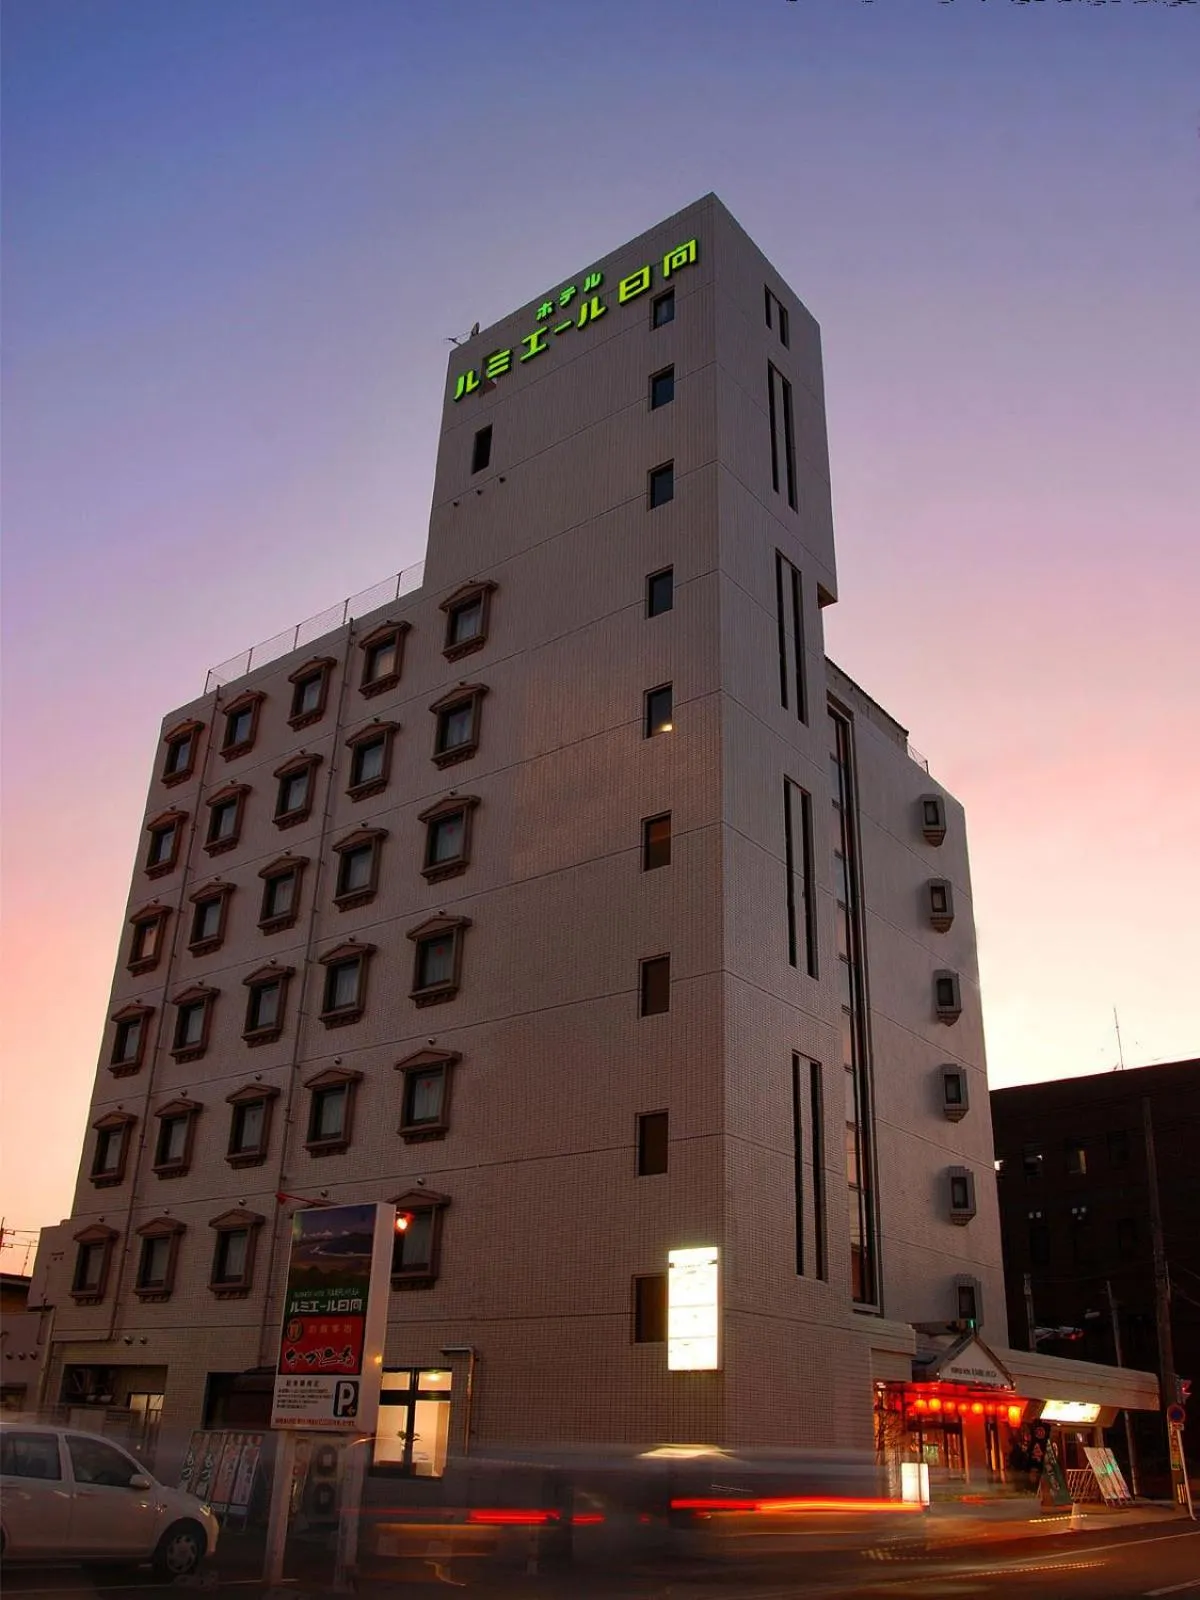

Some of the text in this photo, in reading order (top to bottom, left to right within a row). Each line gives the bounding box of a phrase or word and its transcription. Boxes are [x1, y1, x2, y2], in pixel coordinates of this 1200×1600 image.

[536, 272, 604, 321] ホテル
[454, 239, 697, 401] ルミエール日向
[290, 1299, 363, 1313] ルミエール日向
[336, 1382, 355, 1416] P
